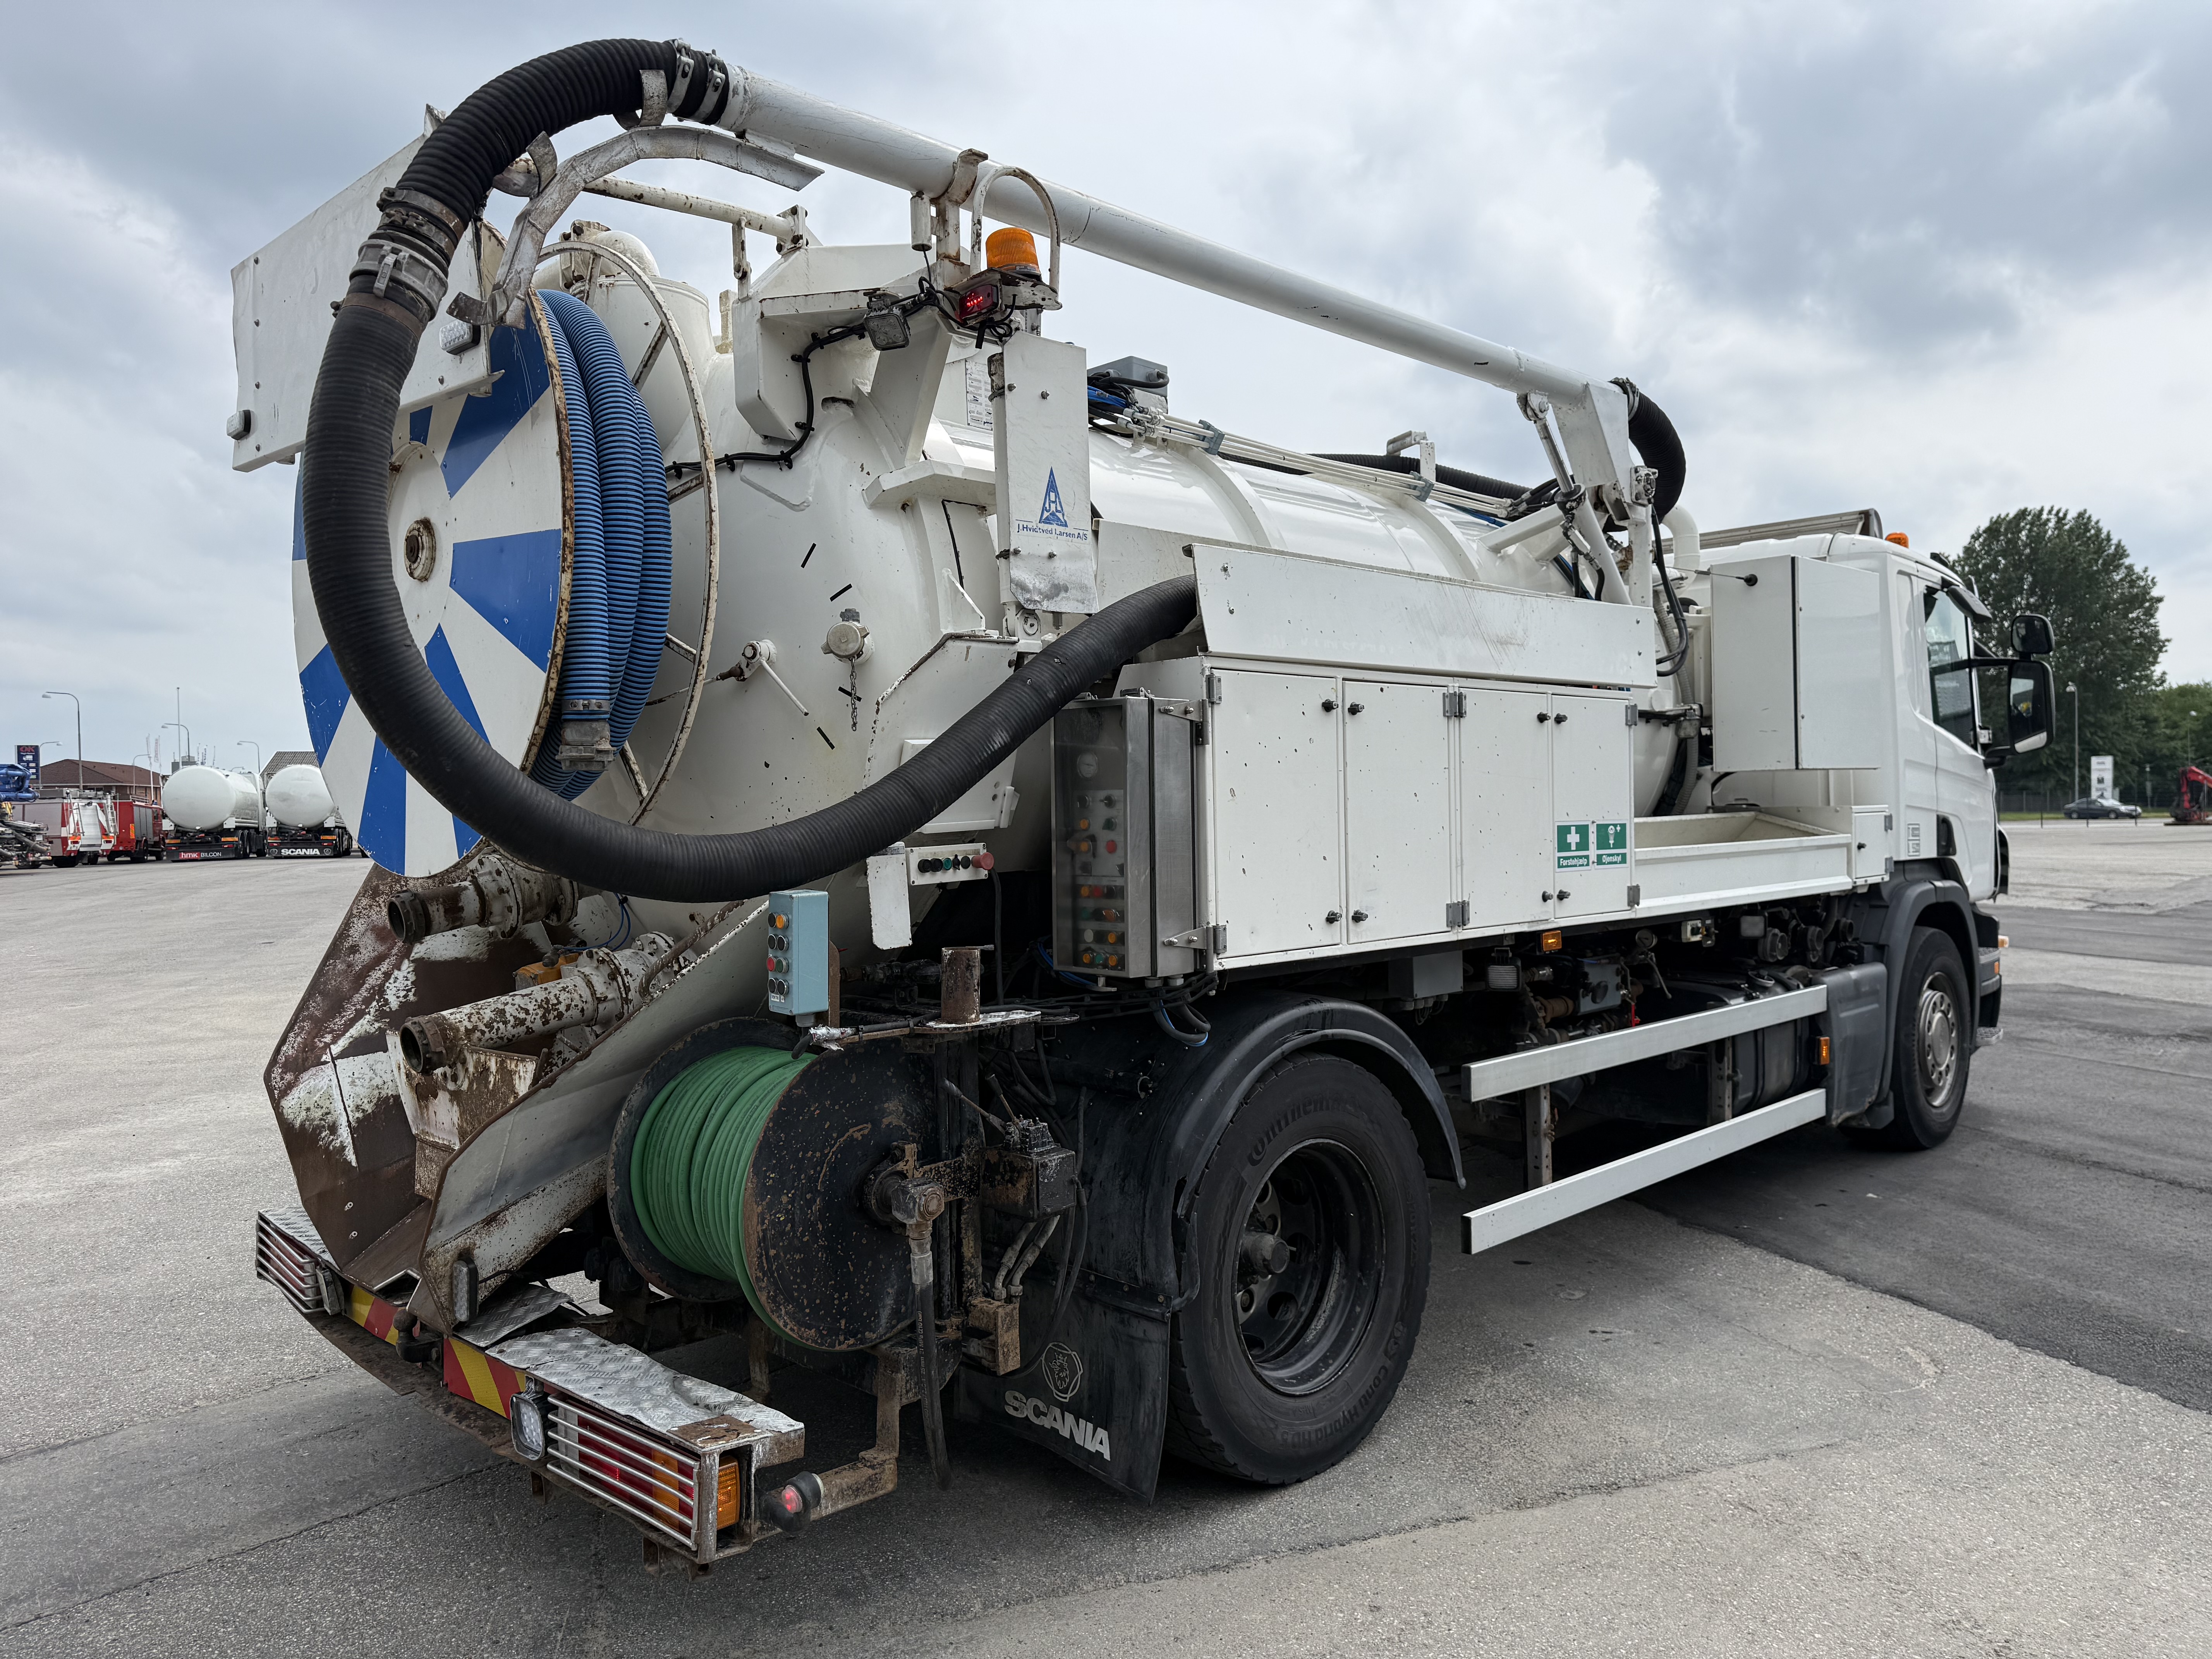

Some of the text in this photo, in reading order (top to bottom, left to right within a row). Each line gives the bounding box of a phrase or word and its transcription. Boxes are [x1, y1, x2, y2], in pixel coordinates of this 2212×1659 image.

[1054, 528, 1075, 538] Larsen
[1077, 532, 1088, 541] A/S
[1004, 1390, 1111, 1461] SCANIA
